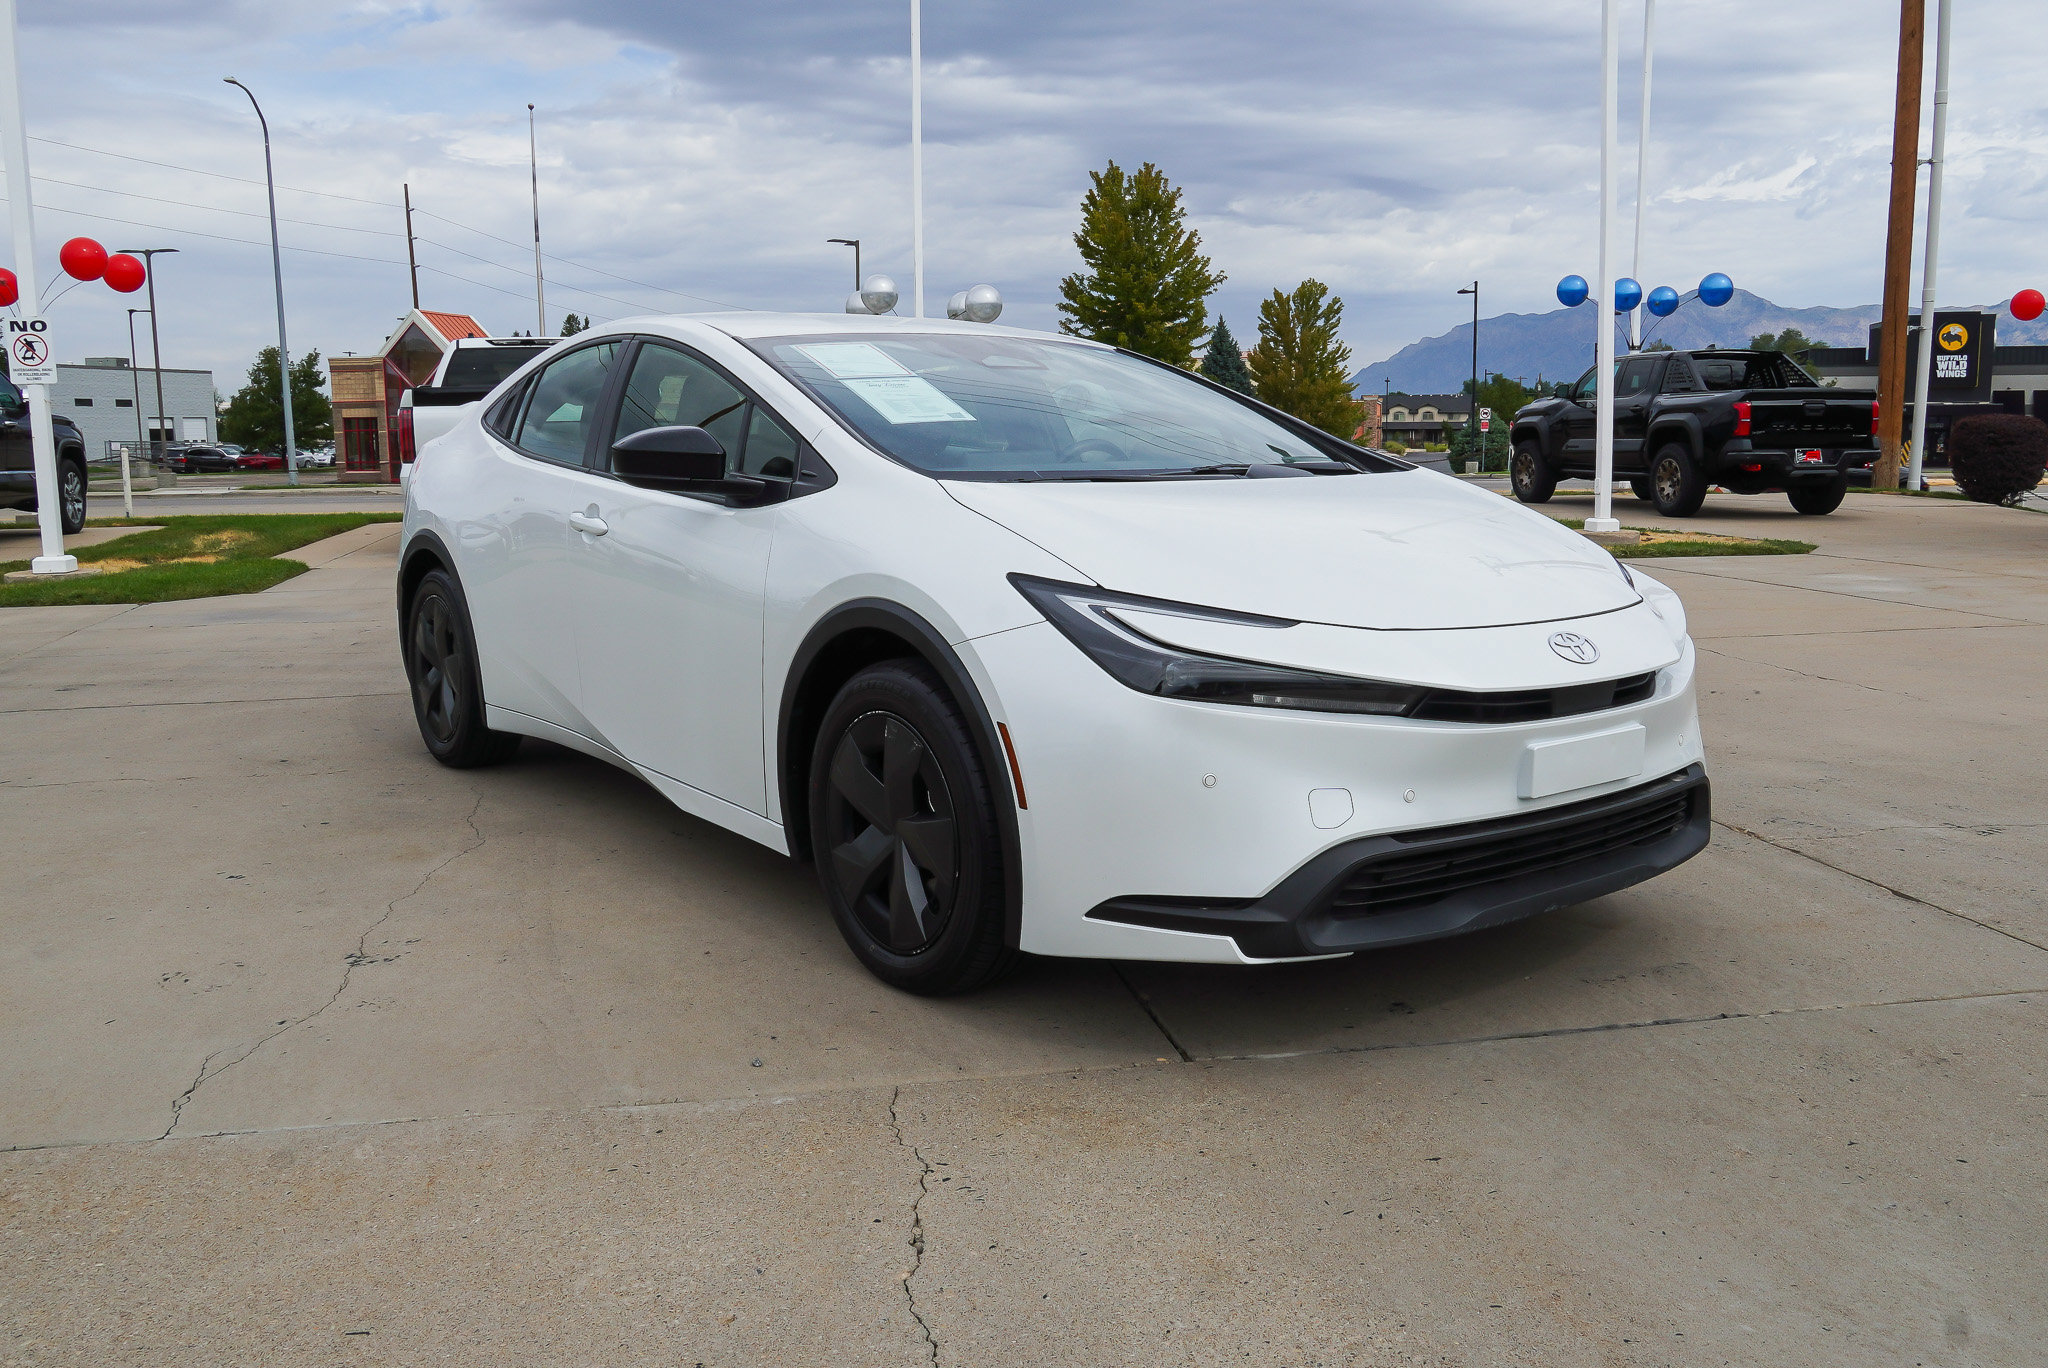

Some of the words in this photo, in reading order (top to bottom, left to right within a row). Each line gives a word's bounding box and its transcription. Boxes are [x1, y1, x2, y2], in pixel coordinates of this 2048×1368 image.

[9, 320, 48, 332] NO
[1936, 360, 1968, 370] WILD
[1936, 370, 1967, 378] WINGS
